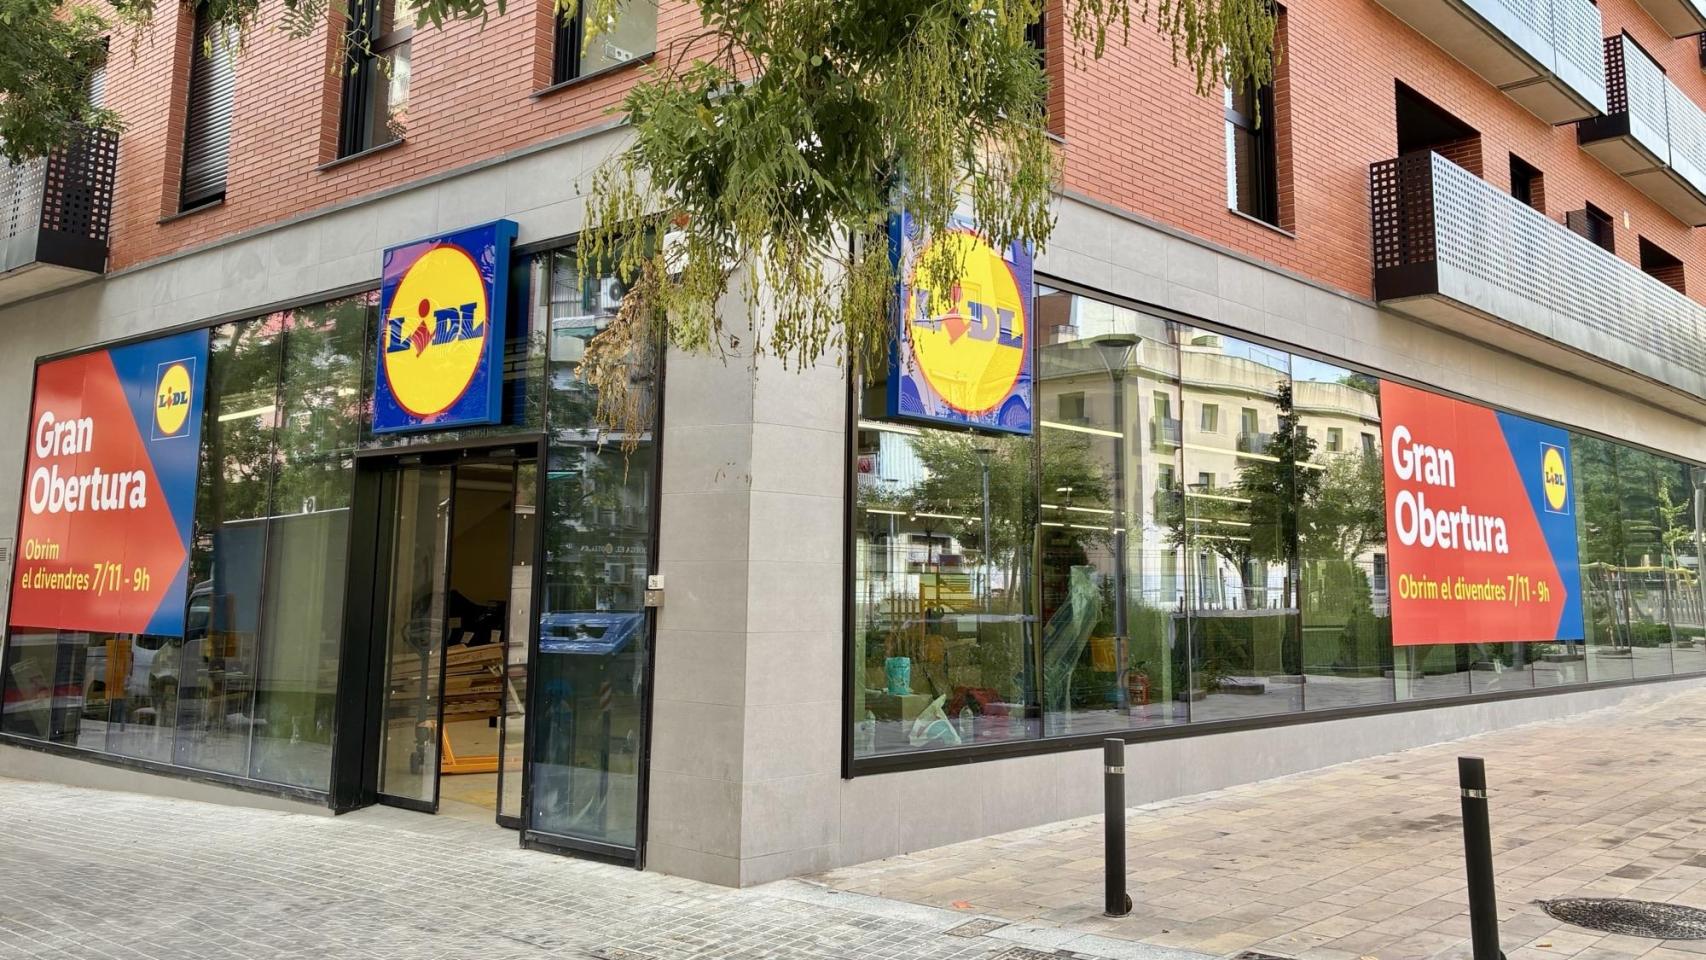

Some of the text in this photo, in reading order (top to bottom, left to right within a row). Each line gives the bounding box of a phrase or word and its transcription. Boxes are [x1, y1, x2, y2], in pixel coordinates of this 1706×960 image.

[35, 410, 94, 459] Gran
[1391, 425, 1456, 488] Gran
[29, 466, 147, 515] Obertura
[1394, 490, 1509, 554] Obertura
[25, 538, 60, 561] Obrim
[21, 570, 33, 590] el
[34, 569, 90, 591] divendres
[92, 563, 121, 597] 7/11
[133, 567, 150, 592] 9h
[1398, 574, 1438, 600] Obrim
[1441, 577, 1451, 601] el
[1454, 578, 1506, 602] divendres
[1507, 574, 1531, 608] 7/11
[1538, 585, 1550, 603] 9h
